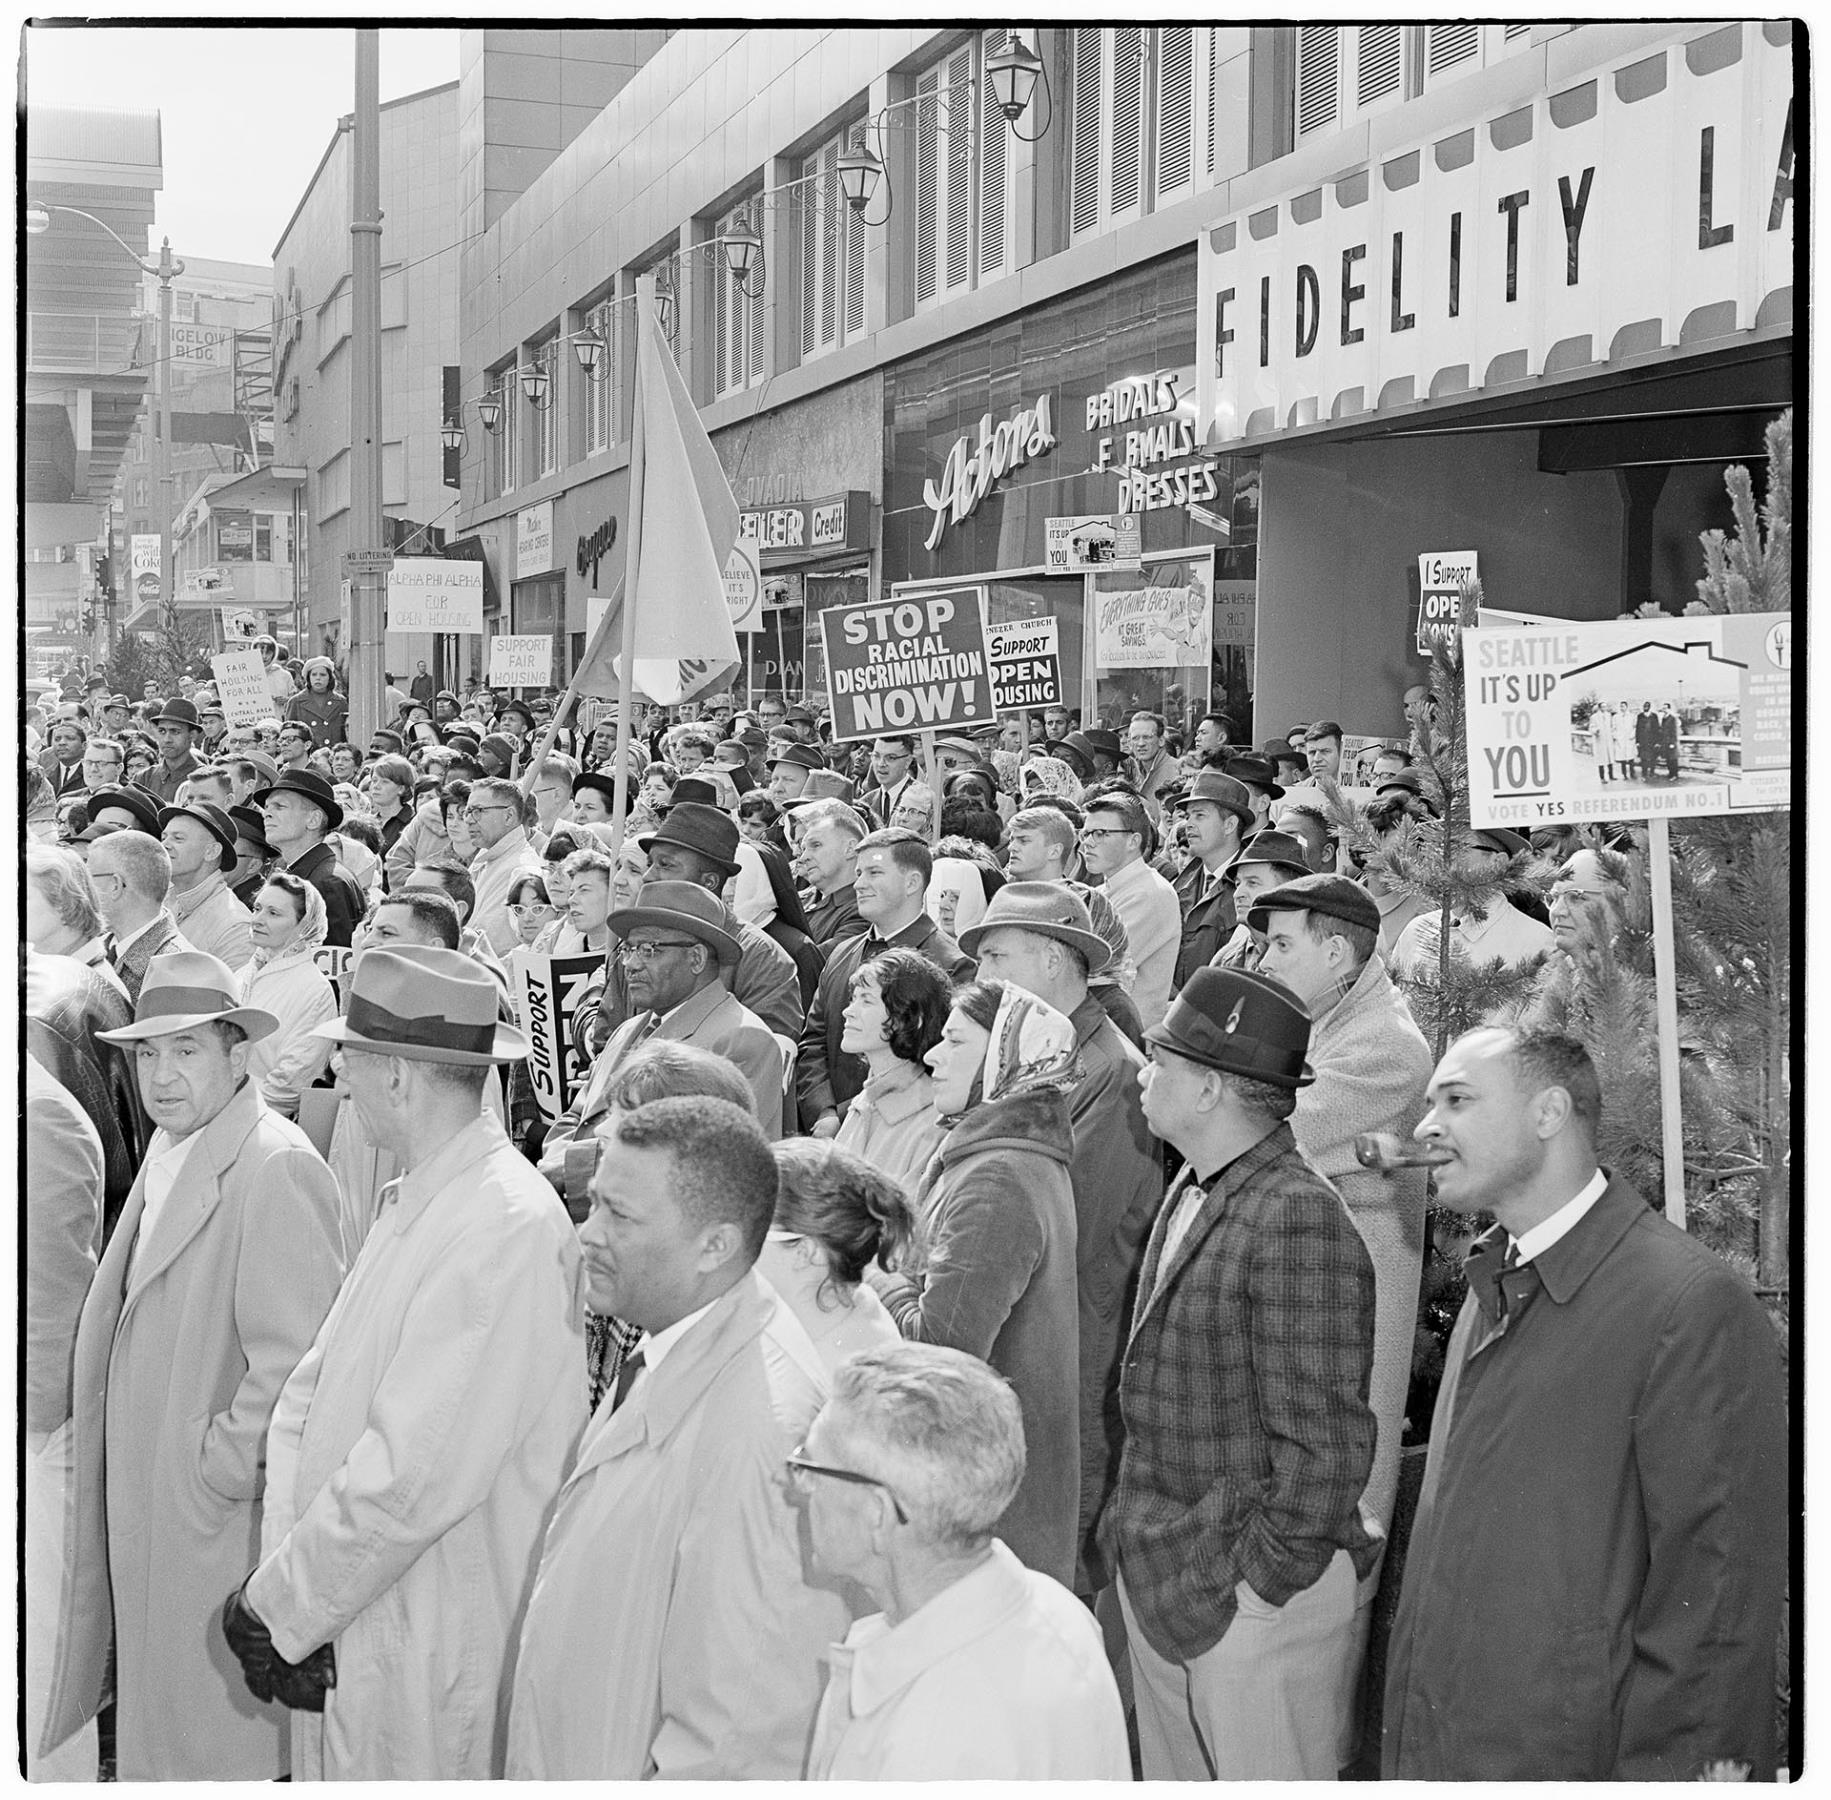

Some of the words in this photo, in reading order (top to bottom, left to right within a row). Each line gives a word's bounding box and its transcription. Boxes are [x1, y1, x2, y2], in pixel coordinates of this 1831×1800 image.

[1215, 166, 1596, 379] FIDELITY
[171, 327, 226, 346] IGELOW
[1086, 374, 1179, 432] BRIDALS
[922, 393, 1057, 551] Actons
[1118, 461, 1219, 515] DRESSES
[814, 506, 843, 538] Credit
[347, 551, 357, 560] NO
[359, 551, 392, 560] LITTERING
[1050, 550, 1068, 563] YOU
[388, 573, 424, 586] ALPHA
[425, 573, 442, 585] PHI
[445, 575, 482, 588] ALPHA
[1425, 560, 1430, 585] I
[1433, 559, 1472, 585] SUPPORT
[728, 583, 744, 593] IT'S
[425, 595, 449, 609] FOR
[1147, 589, 1171, 612] GOES
[1426, 595, 1460, 619] OPE
[395, 611, 422, 626] OPEN
[843, 598, 955, 645] STOP
[1125, 622, 1146, 636] GREAT
[496, 639, 548, 652] SUPPORT
[868, 634, 950, 664] RACIAL
[990, 636, 1050, 658] SUPPORT
[1121, 635, 1147, 648] SAVINGS
[1478, 635, 1579, 669] SEATTLE
[226, 662, 248, 674] FAIR
[509, 654, 535, 667] FAIR
[834, 650, 983, 695] DISCRIMINATION
[220, 674, 263, 688] HOUSING
[495, 671, 547, 685] HOUSING
[1480, 673, 1520, 704] IT'S
[1527, 673, 1557, 702] UP
[227, 687, 245, 698] FOR
[246, 684, 264, 696] ALL
[993, 681, 1055, 706] OUSING
[852, 679, 977, 732] NOW!
[1501, 709, 1532, 739] TO
[1483, 743, 1551, 790] YOU
[1487, 804, 1529, 821] VOTE
[1536, 801, 1565, 817] YES
[1572, 794, 1679, 815] REFERENDUM
[525, 969, 554, 1096] SUPPORT
